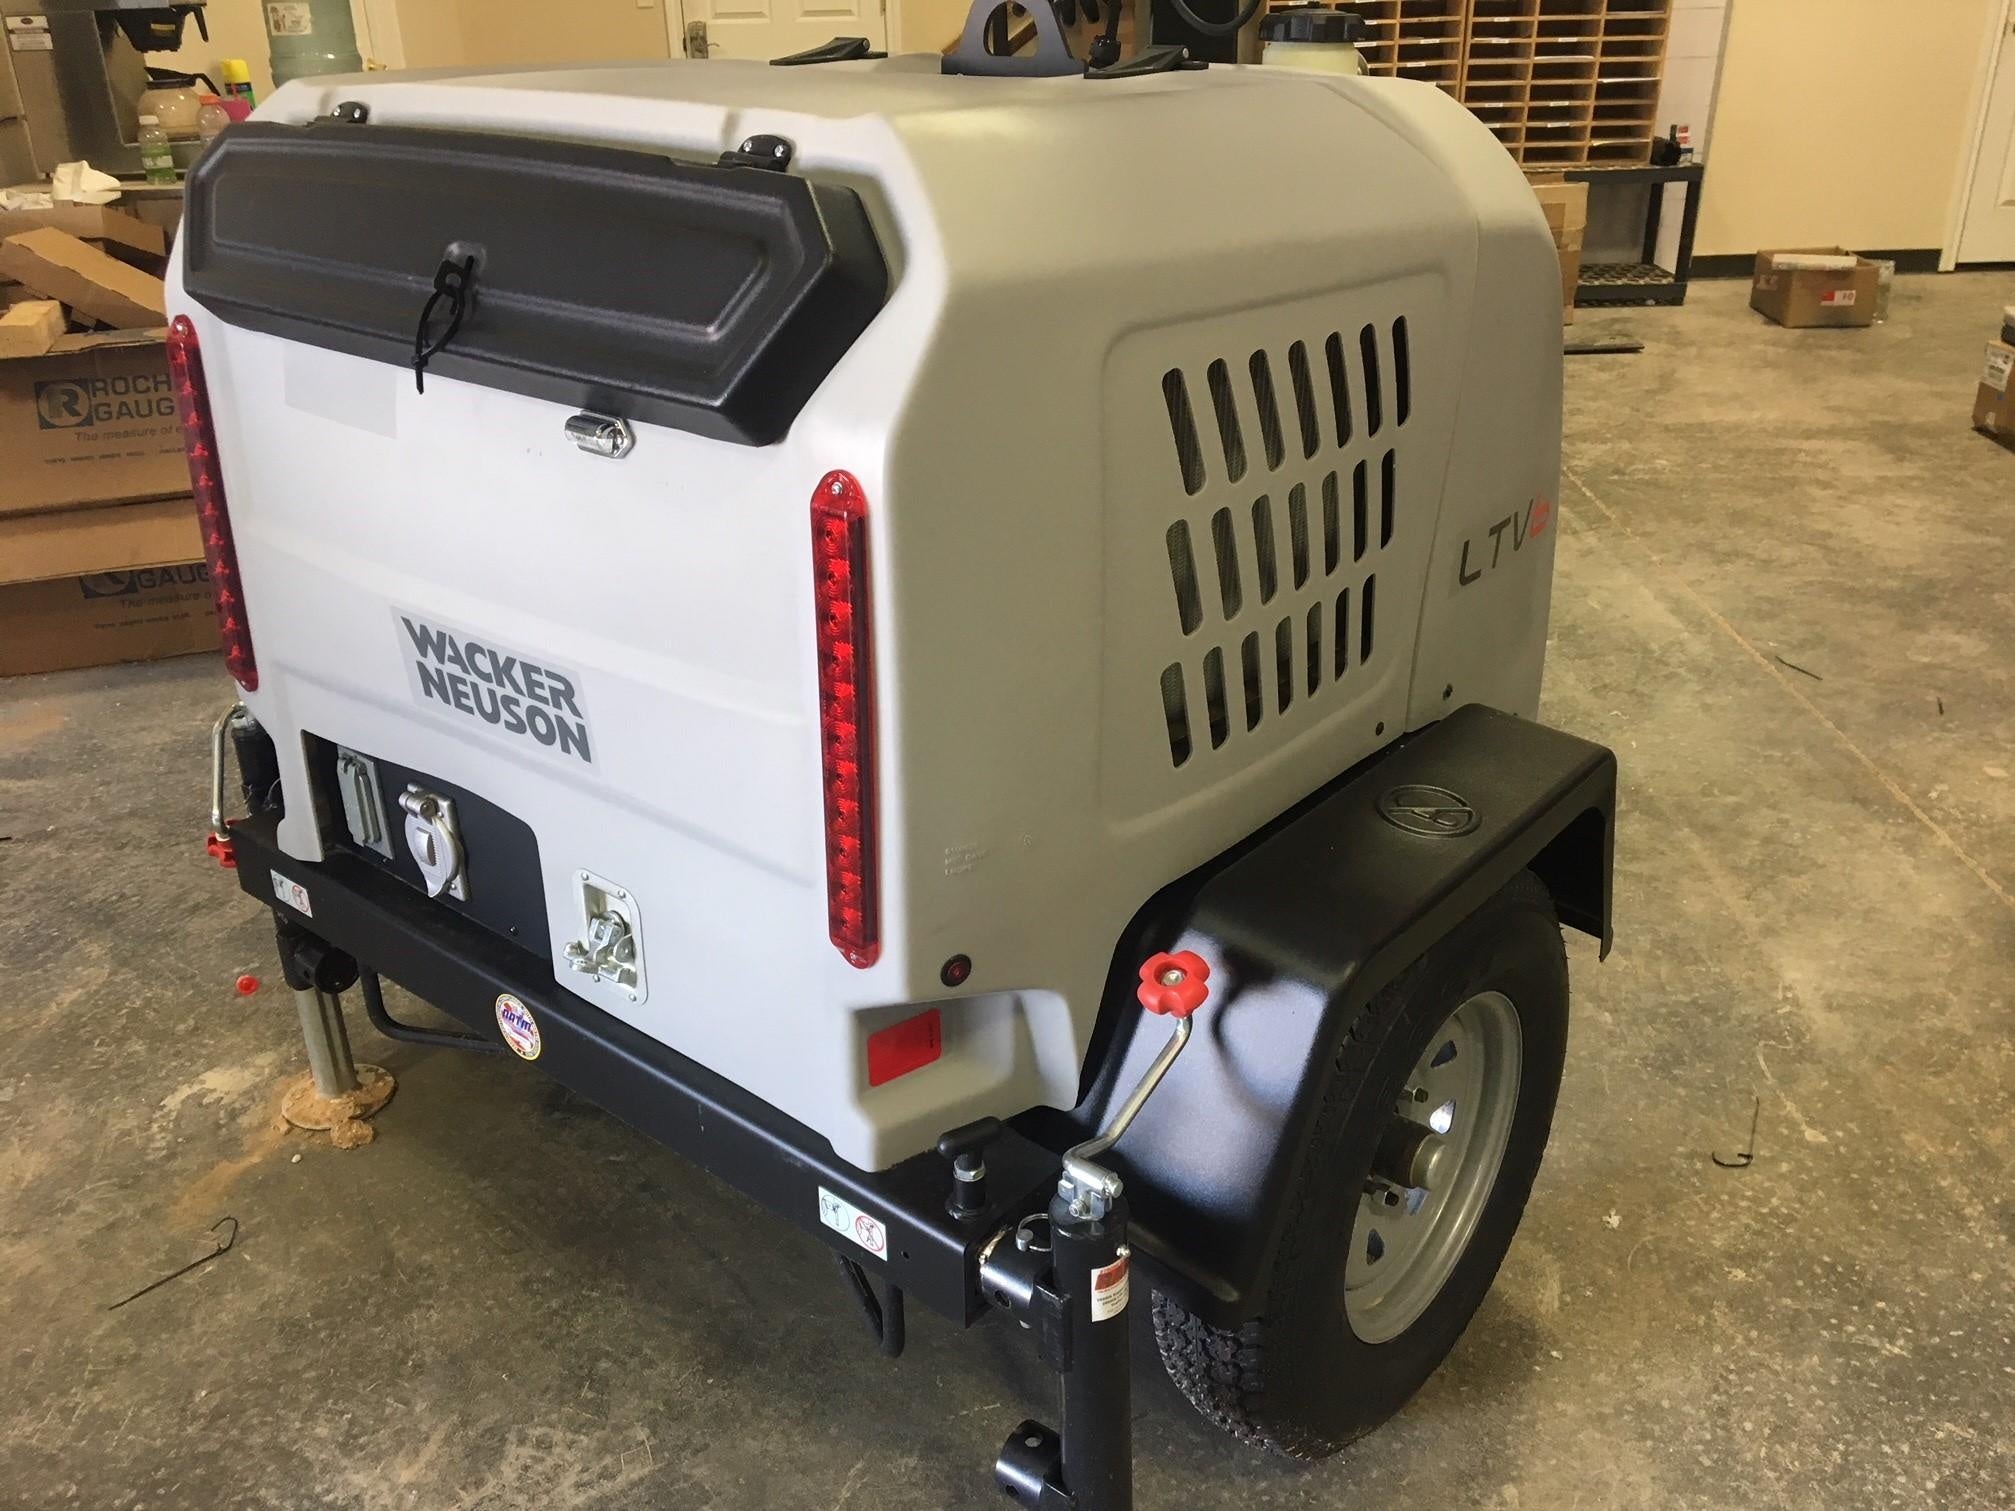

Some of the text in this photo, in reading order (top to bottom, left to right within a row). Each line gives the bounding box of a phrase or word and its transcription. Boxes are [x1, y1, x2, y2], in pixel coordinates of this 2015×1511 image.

[75, 431, 98, 441] The
[103, 427, 157, 440] measure
[160, 424, 174, 435] of
[400, 615, 584, 721] WACKER
[415, 659, 592, 764] NEUSON
